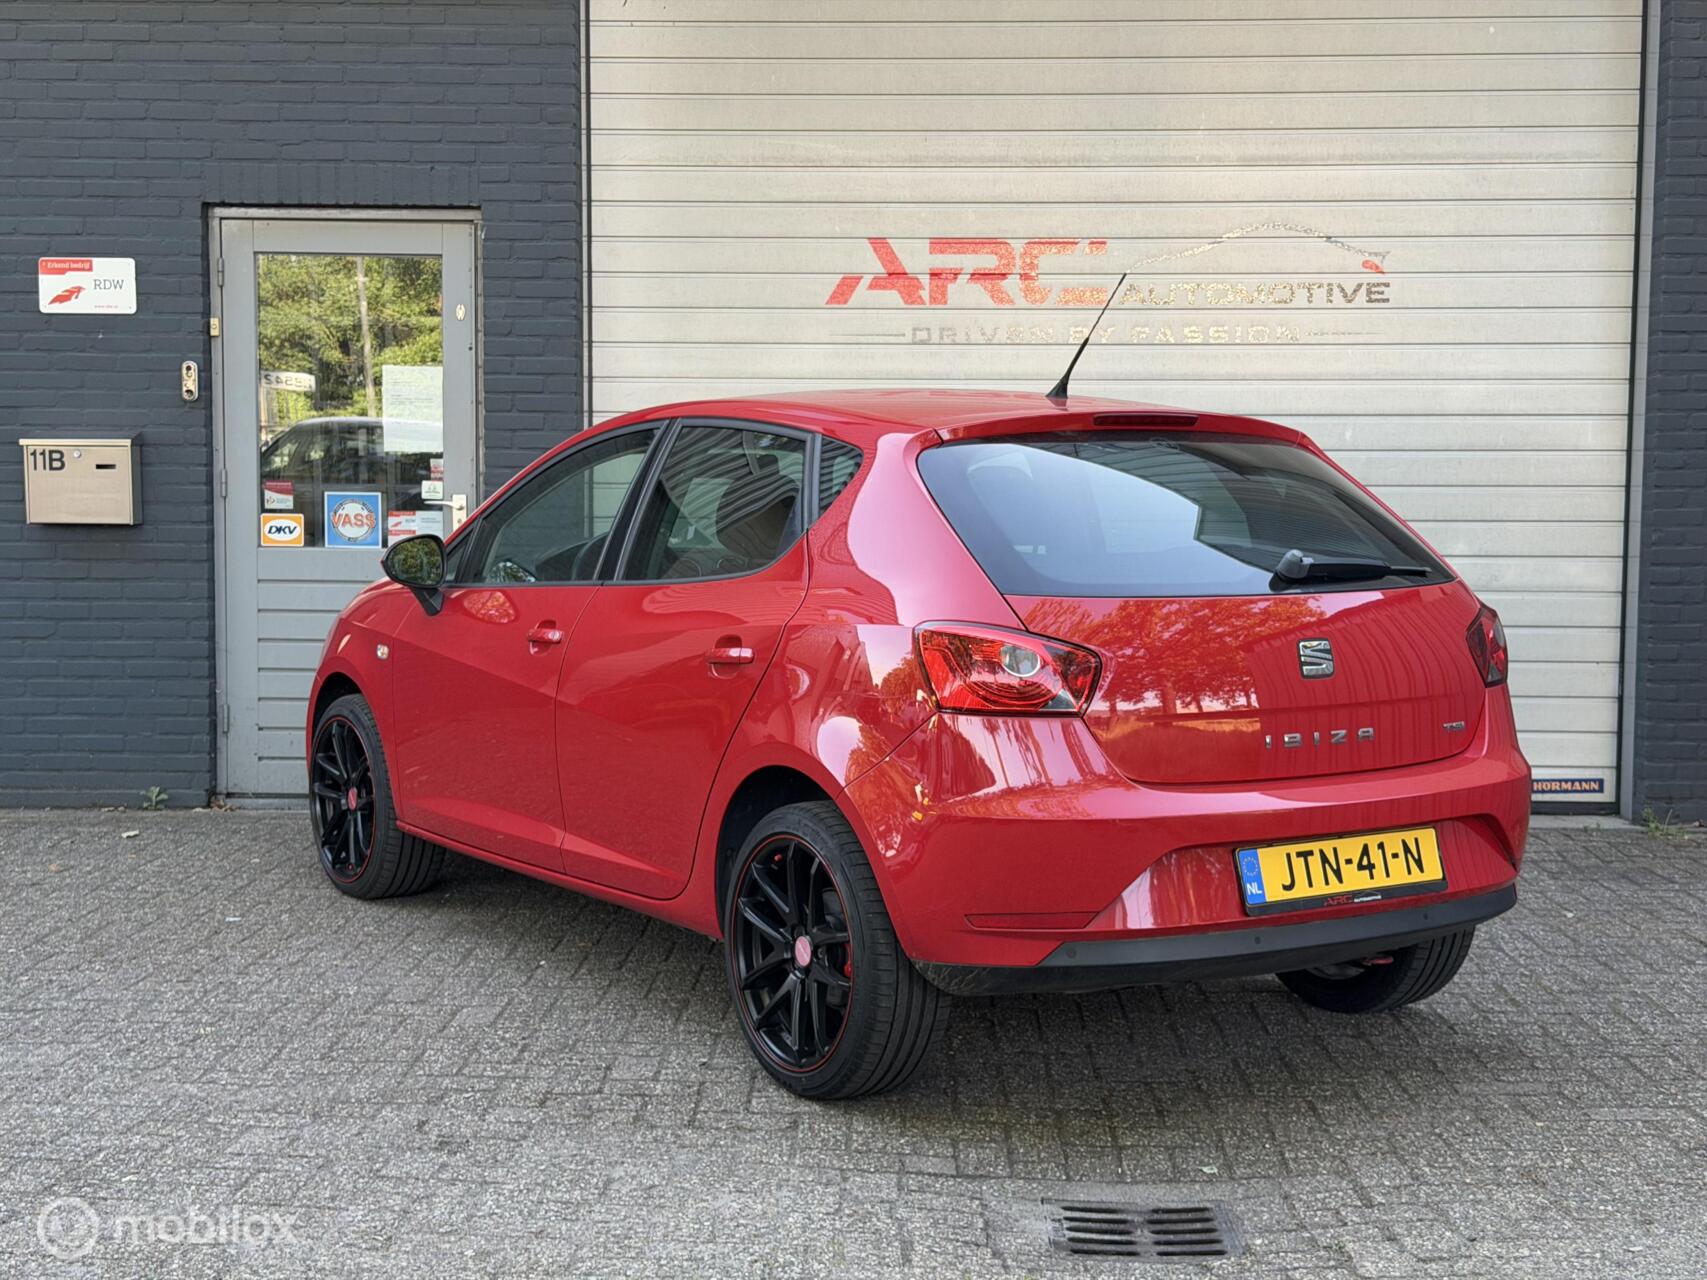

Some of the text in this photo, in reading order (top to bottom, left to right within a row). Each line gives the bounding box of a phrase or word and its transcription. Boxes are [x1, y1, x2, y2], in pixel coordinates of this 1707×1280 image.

[825, 237, 1108, 306] ARC
[93, 279, 125, 290] RDW
[1120, 281, 1391, 305] AUTOMOTIVE
[1068, 326, 1115, 344] BY
[30, 449, 66, 471] 11B
[267, 525, 297, 535] DKV
[1265, 727, 1374, 748] IBIZA
[1281, 836, 1425, 892] JTN-41-N
[1247, 882, 1263, 896] NL
